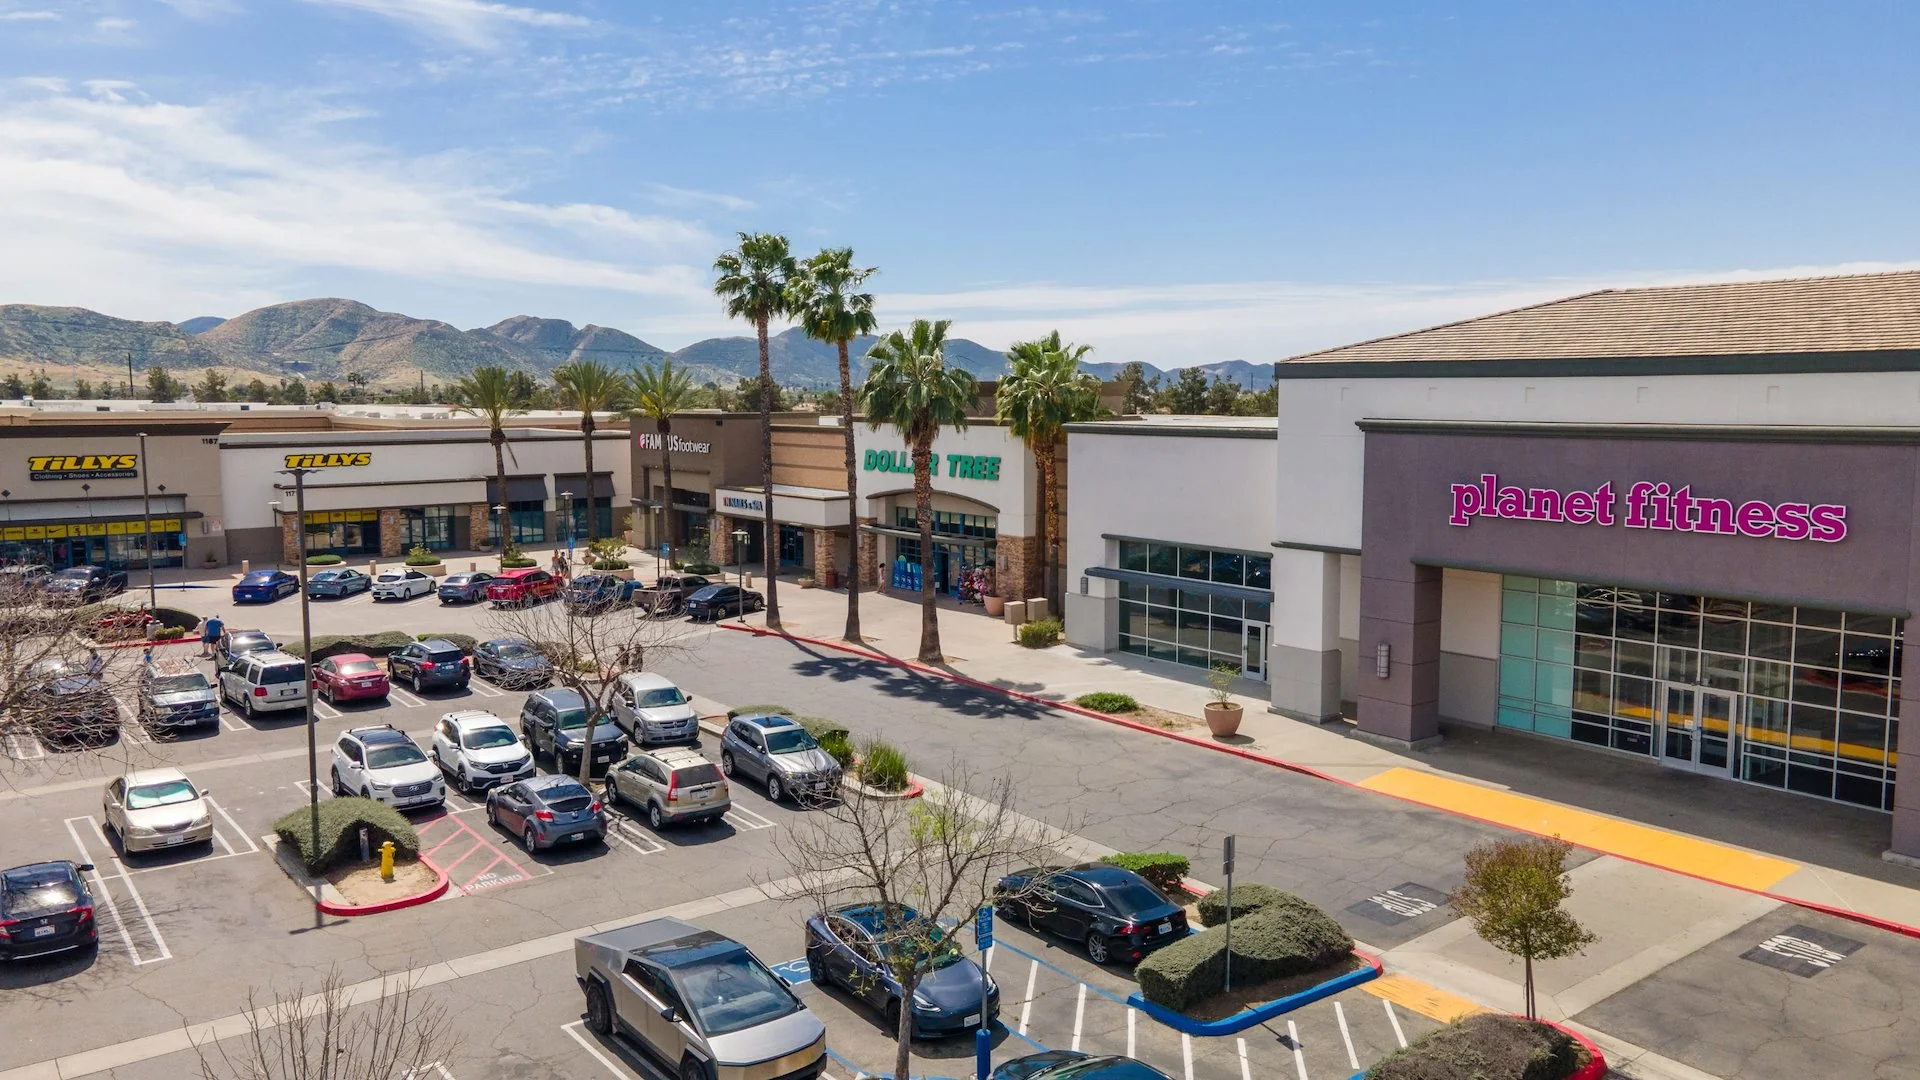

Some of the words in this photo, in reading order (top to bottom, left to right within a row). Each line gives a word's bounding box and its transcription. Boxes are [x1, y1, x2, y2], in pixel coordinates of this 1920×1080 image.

[646, 433, 679, 451] FAMUS
[864, 449, 939, 477] DOLLR
[947, 454, 1001, 481] TREE
[95, 471, 135, 479] Accessories
[1449, 473, 1616, 527] planet
[1624, 482, 1848, 543] fitness
[464, 874, 523, 891] PARKING
[478, 872, 497, 881] NO
